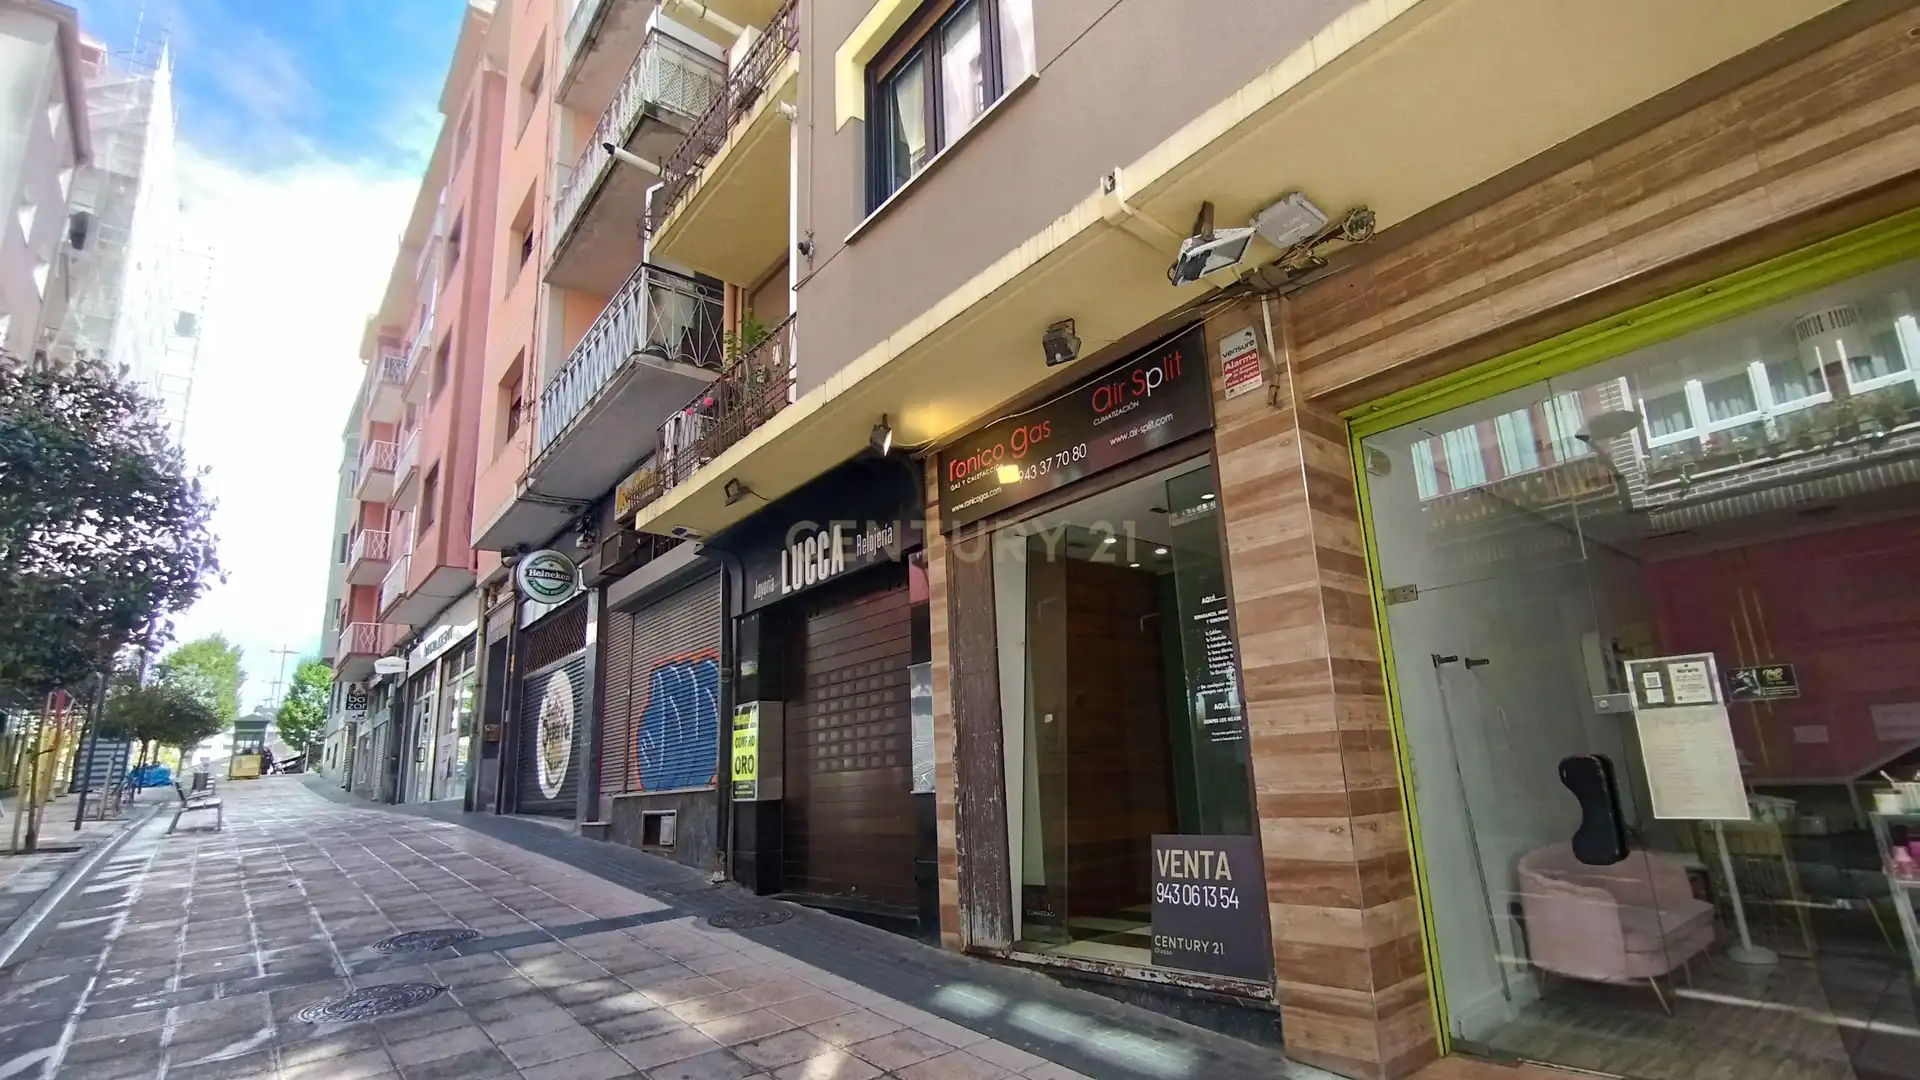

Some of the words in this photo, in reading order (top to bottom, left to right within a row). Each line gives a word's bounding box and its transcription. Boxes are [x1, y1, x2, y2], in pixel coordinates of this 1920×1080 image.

[1222, 339, 1255, 358] verisure
[1225, 352, 1257, 372] Alarma
[1092, 380, 1127, 413] air
[1093, 400, 1140, 426] CLIMATIZACIÓN
[1109, 413, 1174, 446] www.air-split.com
[949, 444, 1004, 482] ronico
[1010, 419, 1051, 459] gas
[1018, 464, 1037, 485] 943
[1039, 457, 1053, 476] 37
[1055, 450, 1070, 469] 70
[1072, 442, 1087, 462] 80
[950, 481, 961, 492] GAS
[951, 486, 1003, 513] www.ronicogas.com
[781, 524, 844, 595] LUCCA
[856, 523, 893, 557] Relojería
[528, 569, 571, 581] Heineken
[734, 754, 755, 775] ORO
[1156, 849, 1232, 881] VENTA
[1156, 882, 1180, 904] 943
[1182, 884, 1201, 907] 06
[1202, 885, 1218, 908] 13
[1219, 887, 1240, 910] 54
[1154, 935, 1210, 953] CENTURY
[1212, 942, 1224, 955] 21
